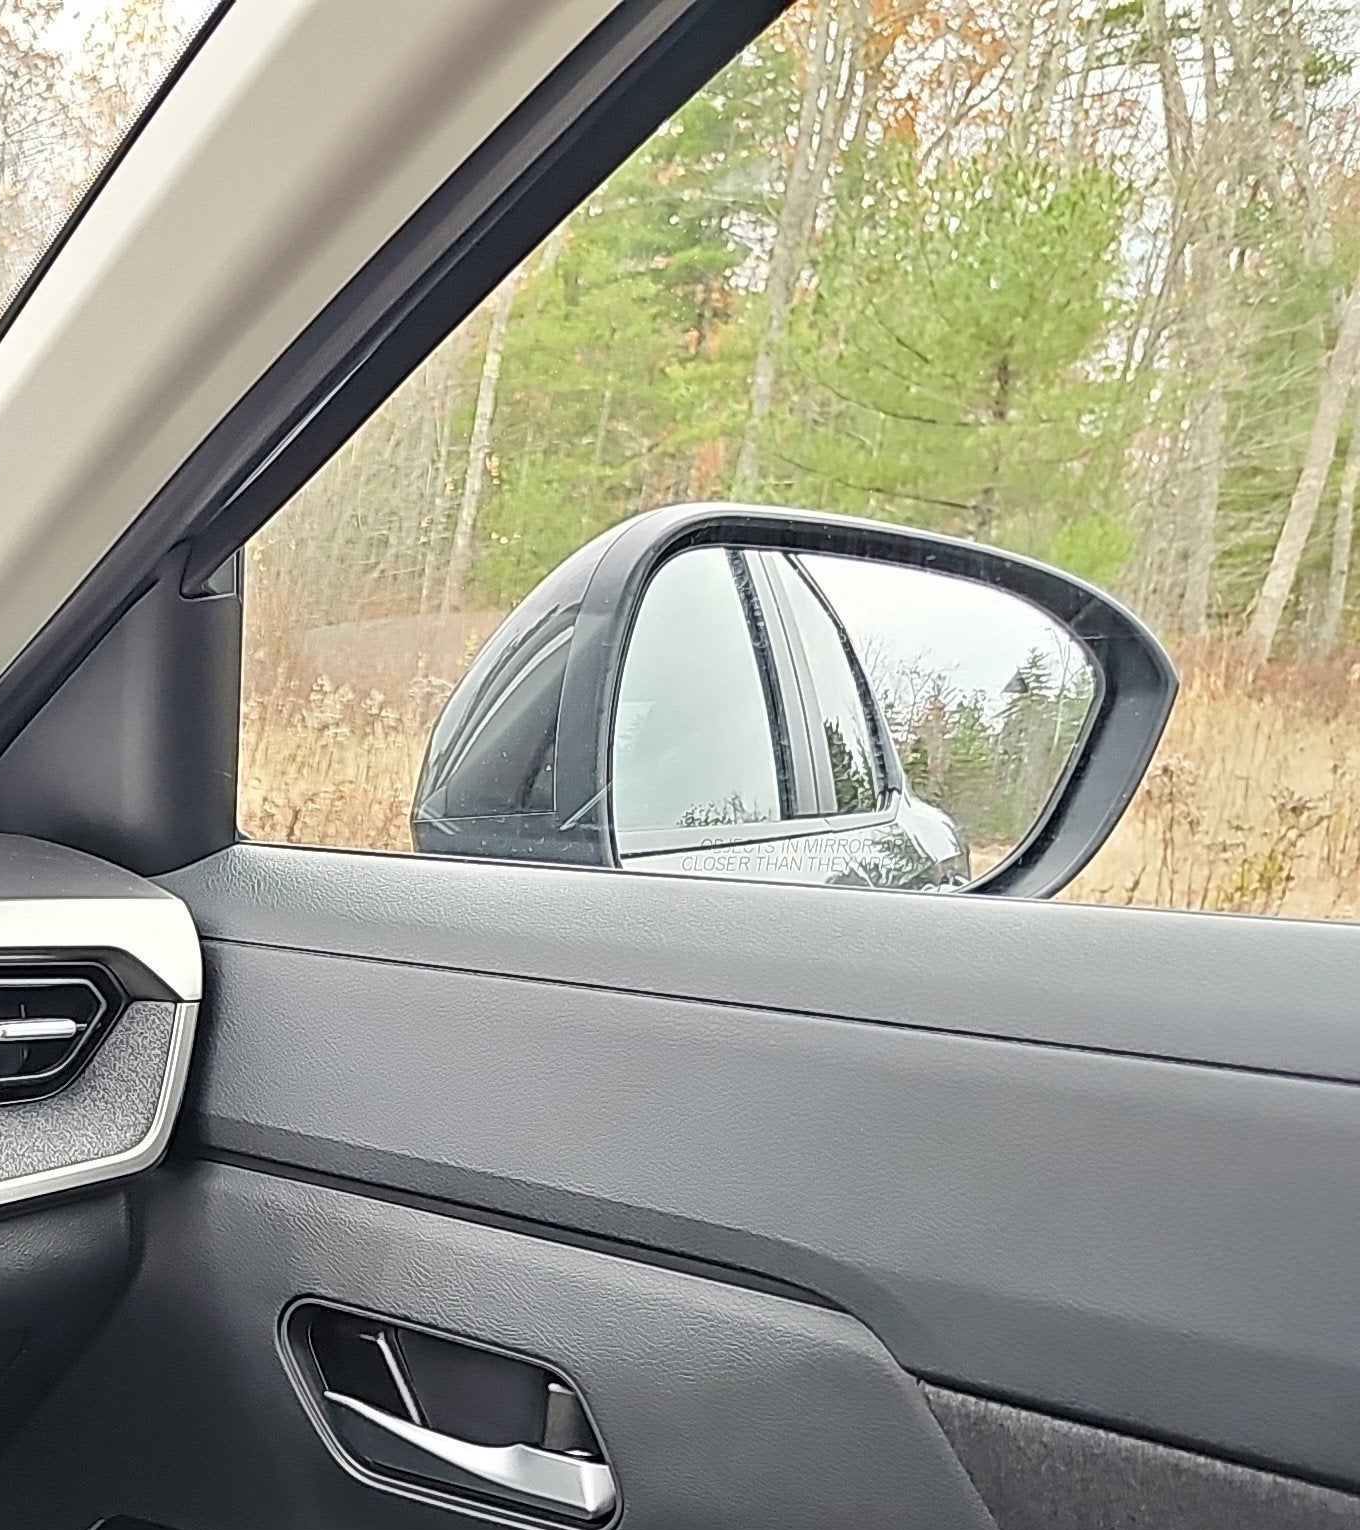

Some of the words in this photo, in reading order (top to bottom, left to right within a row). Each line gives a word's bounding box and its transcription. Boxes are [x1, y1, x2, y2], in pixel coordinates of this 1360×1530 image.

[700, 838, 776, 854] OBJECTS
[781, 838, 802, 854] IN
[803, 838, 874, 854] MIRROR
[681, 856, 751, 872] CLOSER
[756, 856, 803, 872] THAN
[809, 856, 851, 872] THEY
